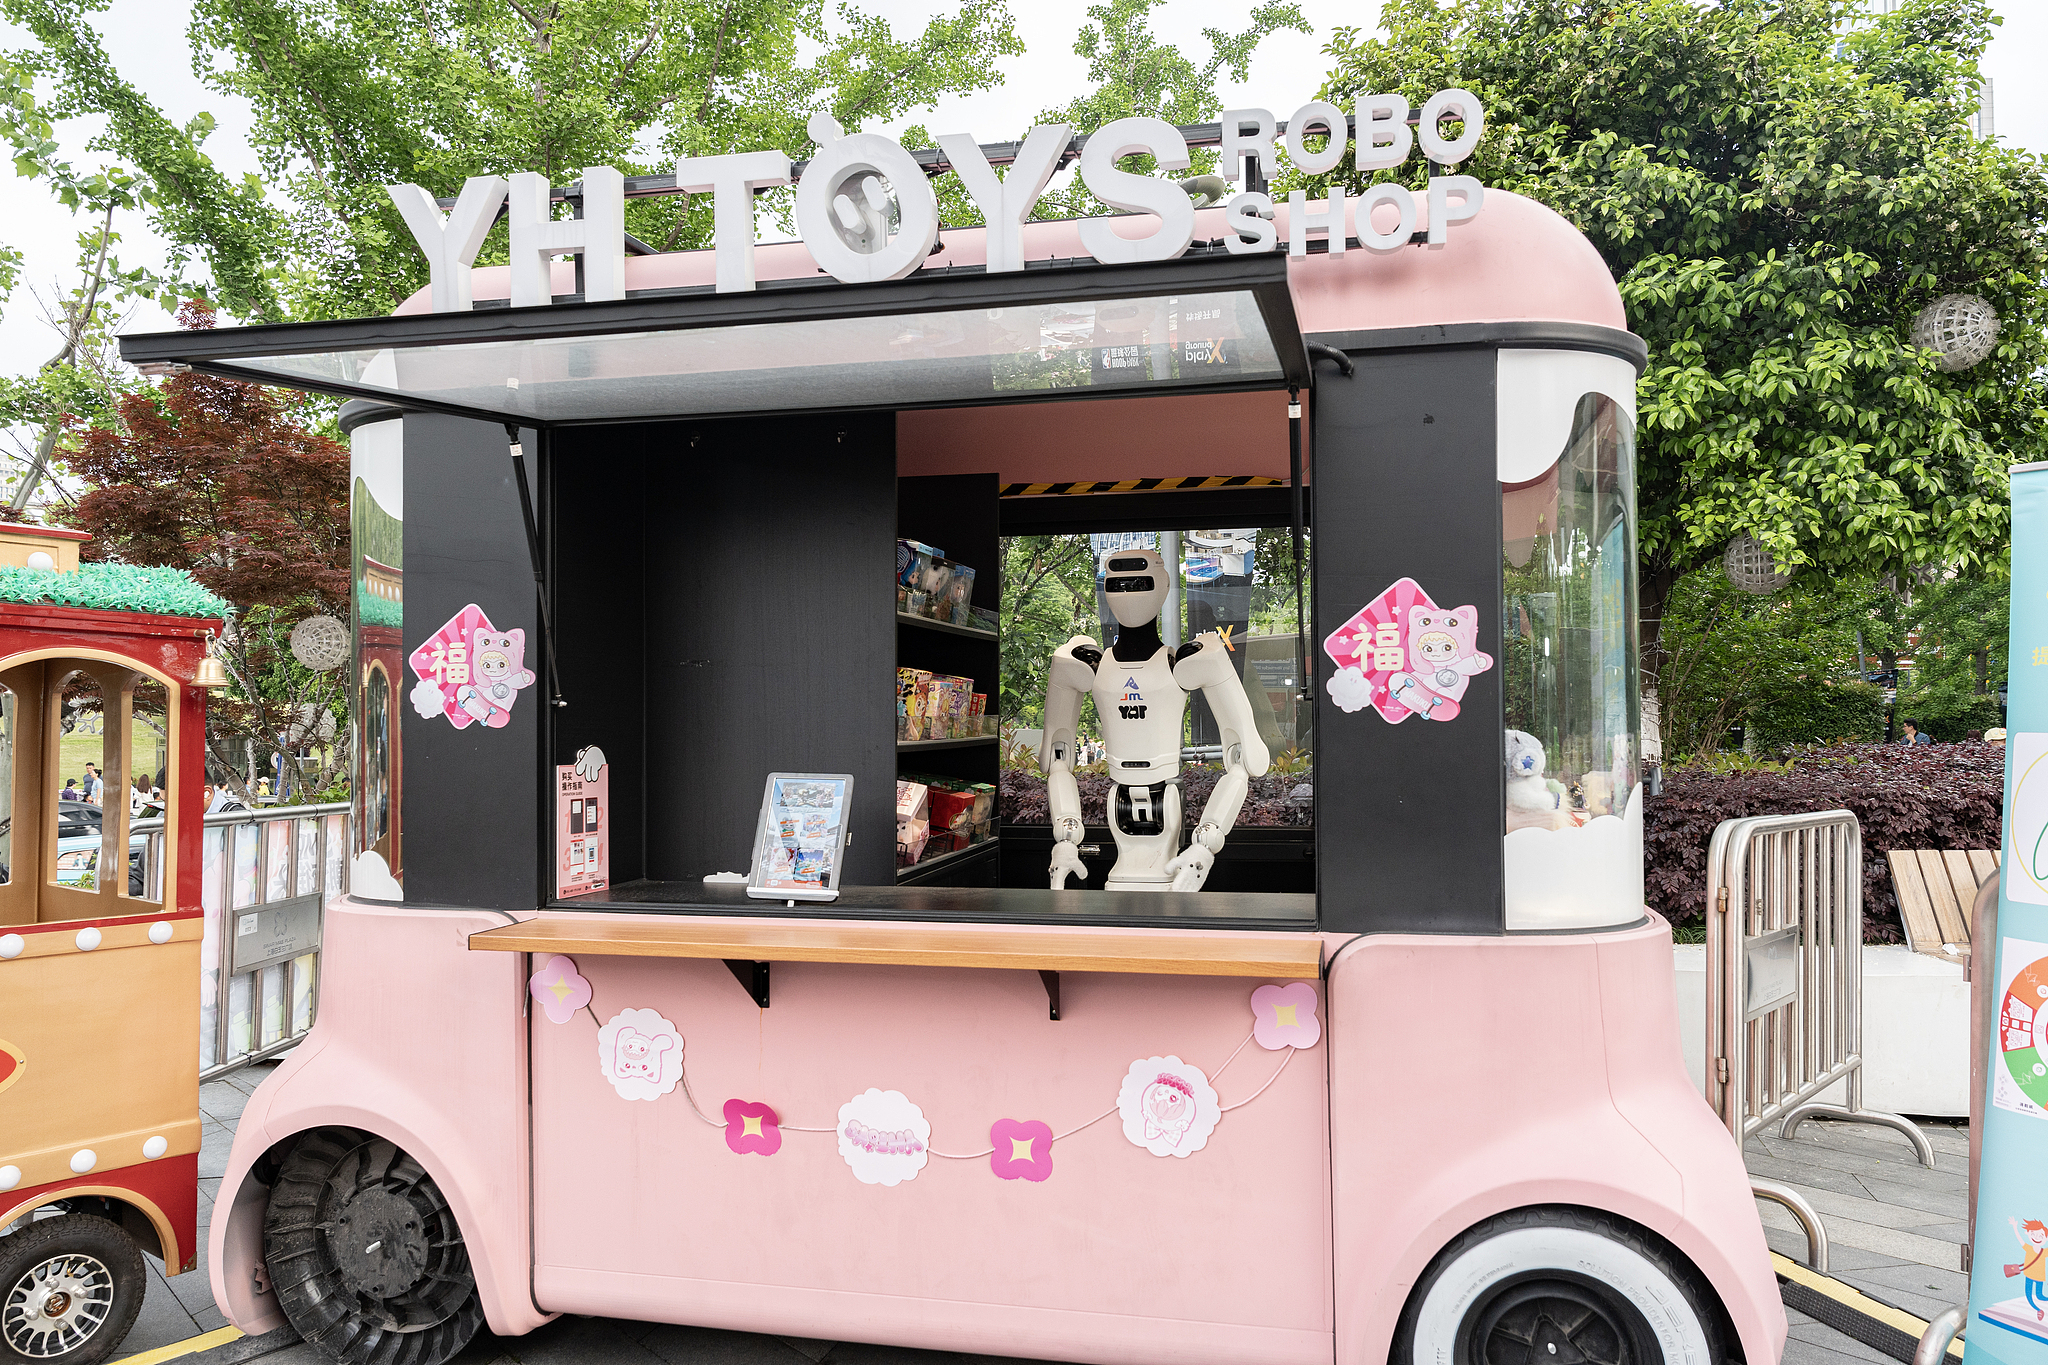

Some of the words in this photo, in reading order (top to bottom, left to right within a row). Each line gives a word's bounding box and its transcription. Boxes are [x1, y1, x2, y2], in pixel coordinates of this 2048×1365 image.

[1222, 88, 1484, 181] ROBO
[386, 165, 625, 313] YH
[677, 112, 1195, 294] TOYS
[1224, 175, 1484, 261] SHOP
[429, 641, 470, 685] 福
[1351, 622, 1405, 672] 福
[1576, 1259, 1626, 1289] SOLUTION
[1625, 1285, 1665, 1330] PROVIDER
[1660, 1328, 1676, 1349] FOR
